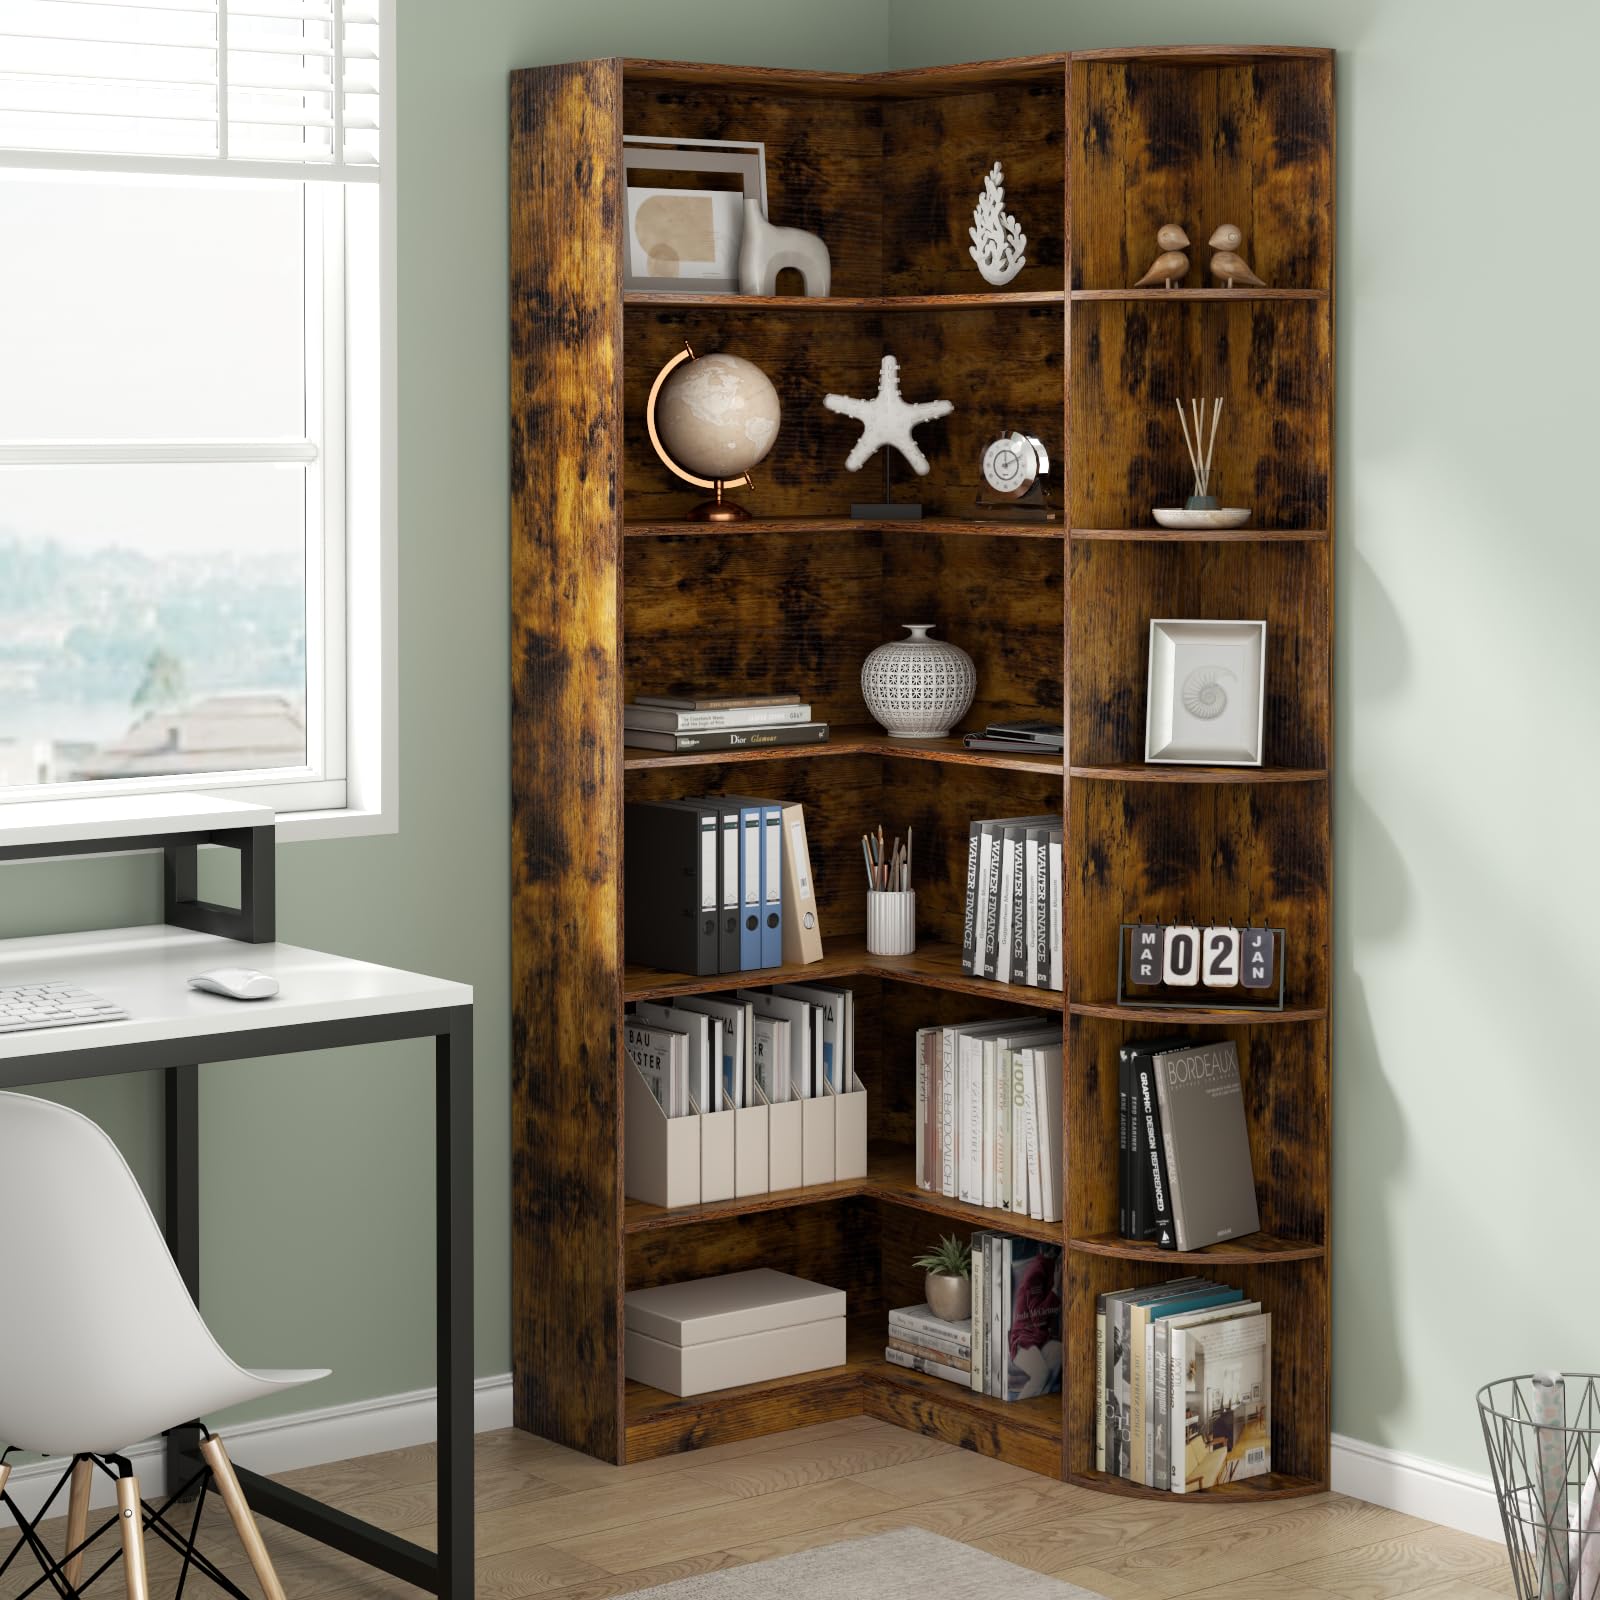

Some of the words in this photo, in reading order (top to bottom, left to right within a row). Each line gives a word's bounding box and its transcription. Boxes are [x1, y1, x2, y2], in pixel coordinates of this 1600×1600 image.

[730, 734, 748, 745] Dior
[968, 836, 978, 890] WALTER
[989, 840, 1000, 895] WALTER
[1014, 841, 1023, 897] WALTER
[1037, 845, 1046, 900] WALTER
[964, 892, 975, 950] FINANCE
[986, 896, 998, 954] FINANCE
[1014, 900, 1023, 959] FINANCE
[1037, 902, 1046, 963] FINANCE
[1141, 933, 1155, 976] MAR
[1251, 936, 1264, 979] JAN
[629, 1030, 650, 1047] BAU
[629, 1050, 661, 1070] ISTER
[1167, 1048, 1237, 1085] BORDEAUX
[1140, 1072, 1151, 1113] GRAPHIC
[1146, 1115, 1156, 1150] DESIGN
[1151, 1151, 1164, 1212] REFERENCED
